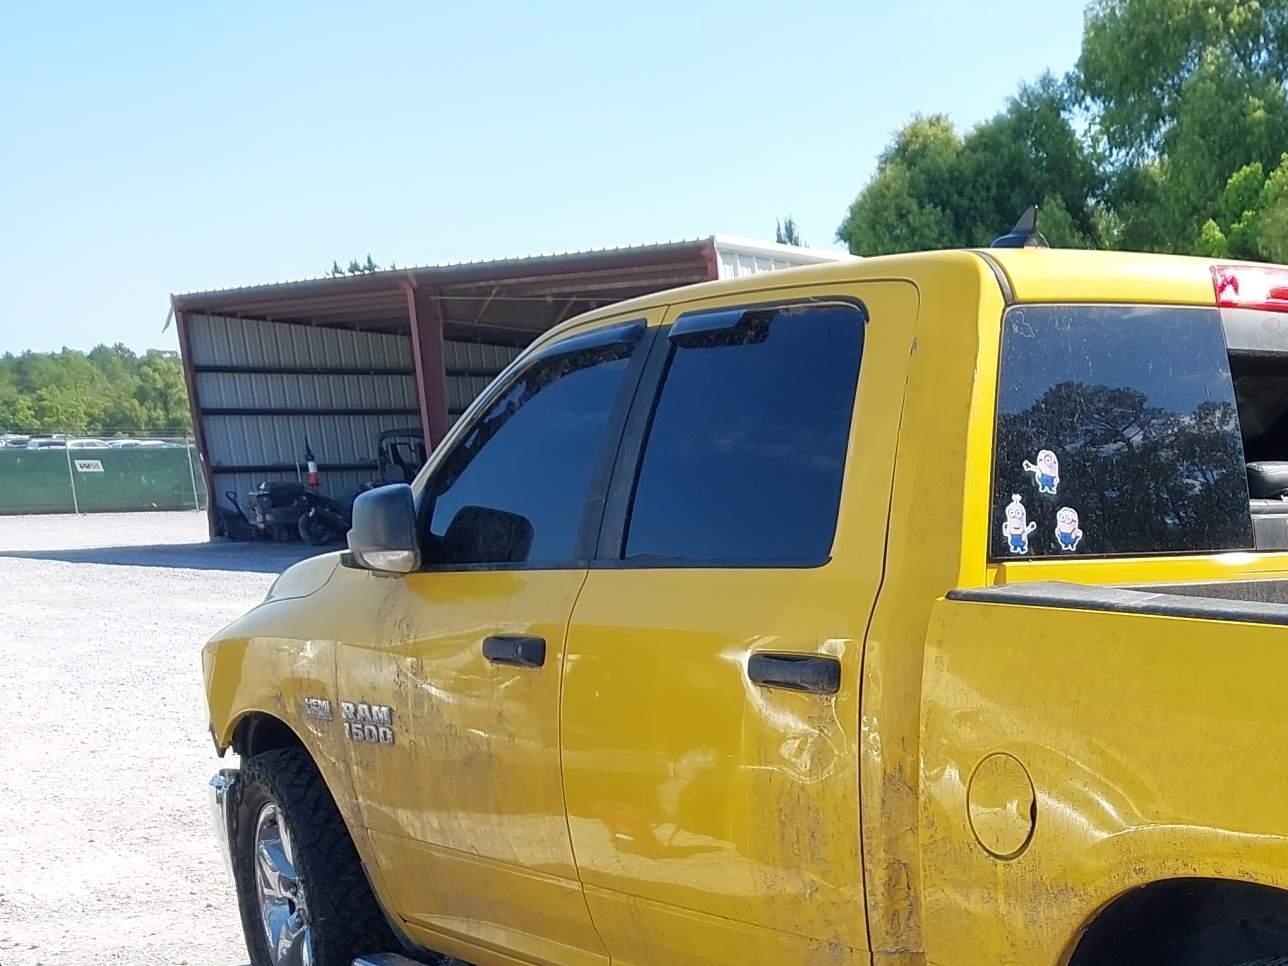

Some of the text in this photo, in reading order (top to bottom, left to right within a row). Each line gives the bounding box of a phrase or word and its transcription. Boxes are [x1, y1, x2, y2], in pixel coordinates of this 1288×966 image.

[304, 697, 330, 712] HEMI
[341, 701, 394, 726] RAM
[343, 721, 395, 745] 1500
